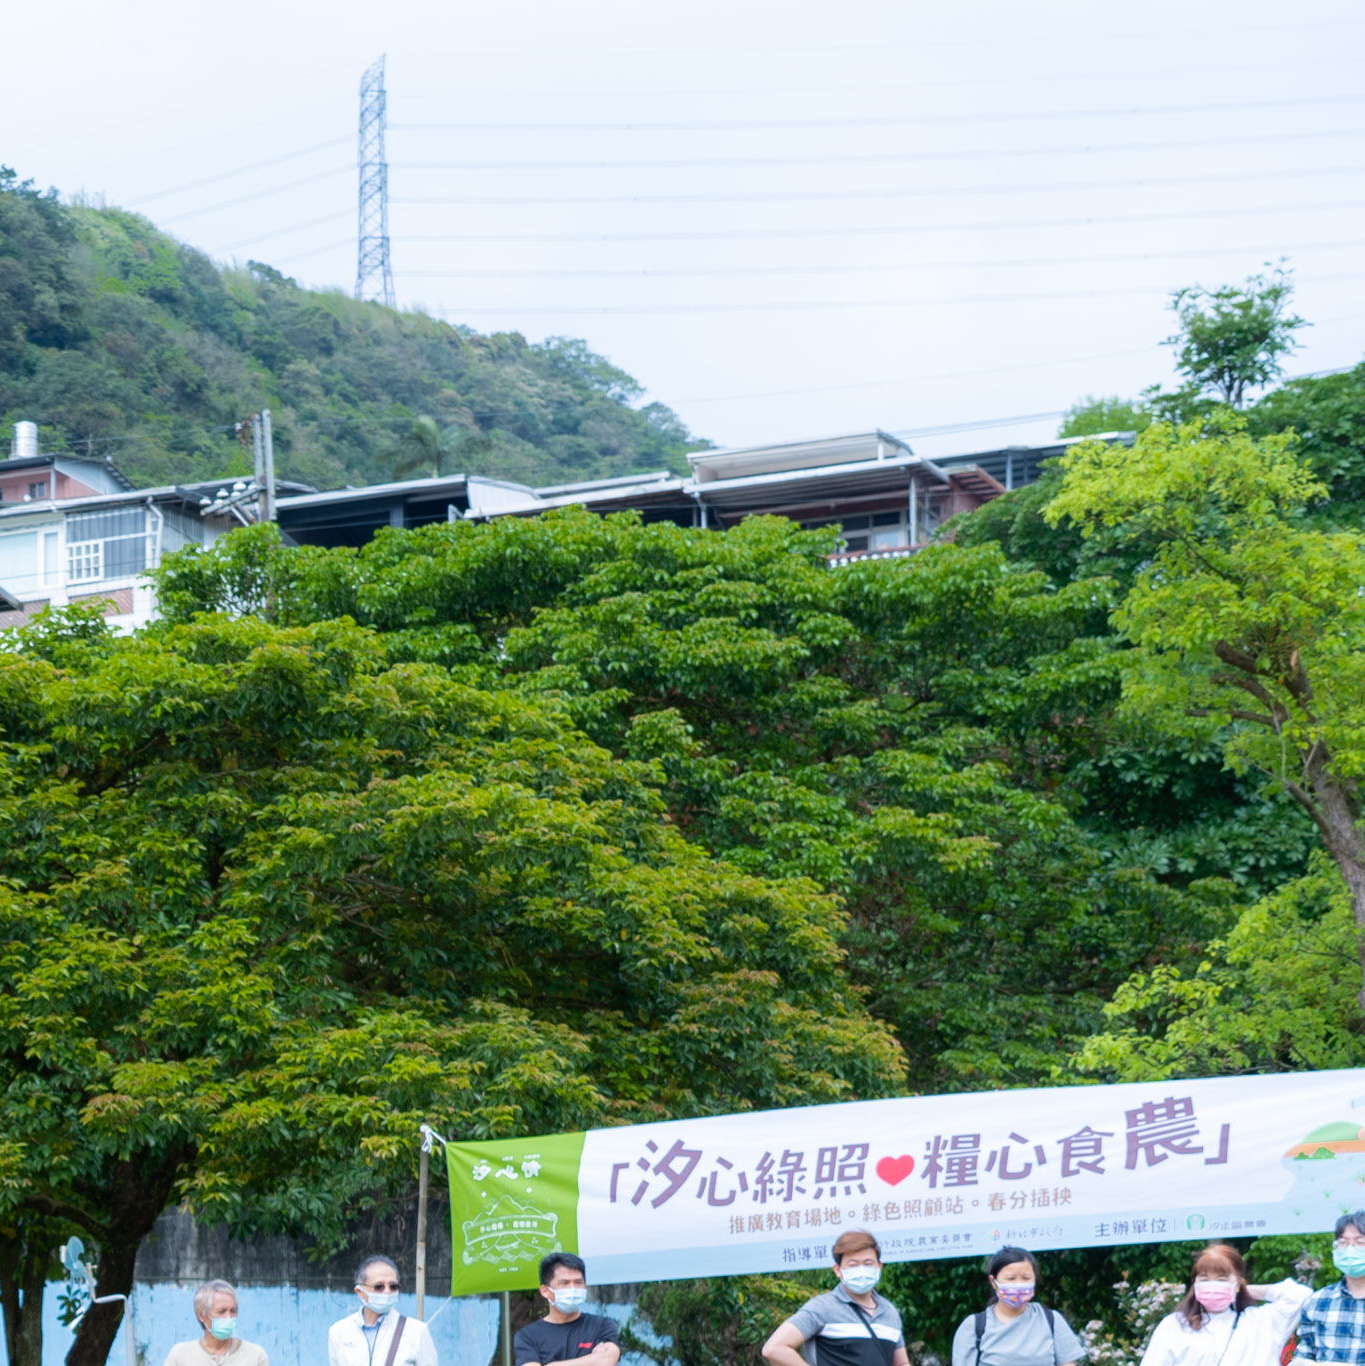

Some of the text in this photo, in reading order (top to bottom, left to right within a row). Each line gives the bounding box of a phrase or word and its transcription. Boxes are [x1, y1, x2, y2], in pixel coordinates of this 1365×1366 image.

[1094, 1217, 1167, 1238] 主辦單位
[781, 1244, 829, 1263] 指導單
